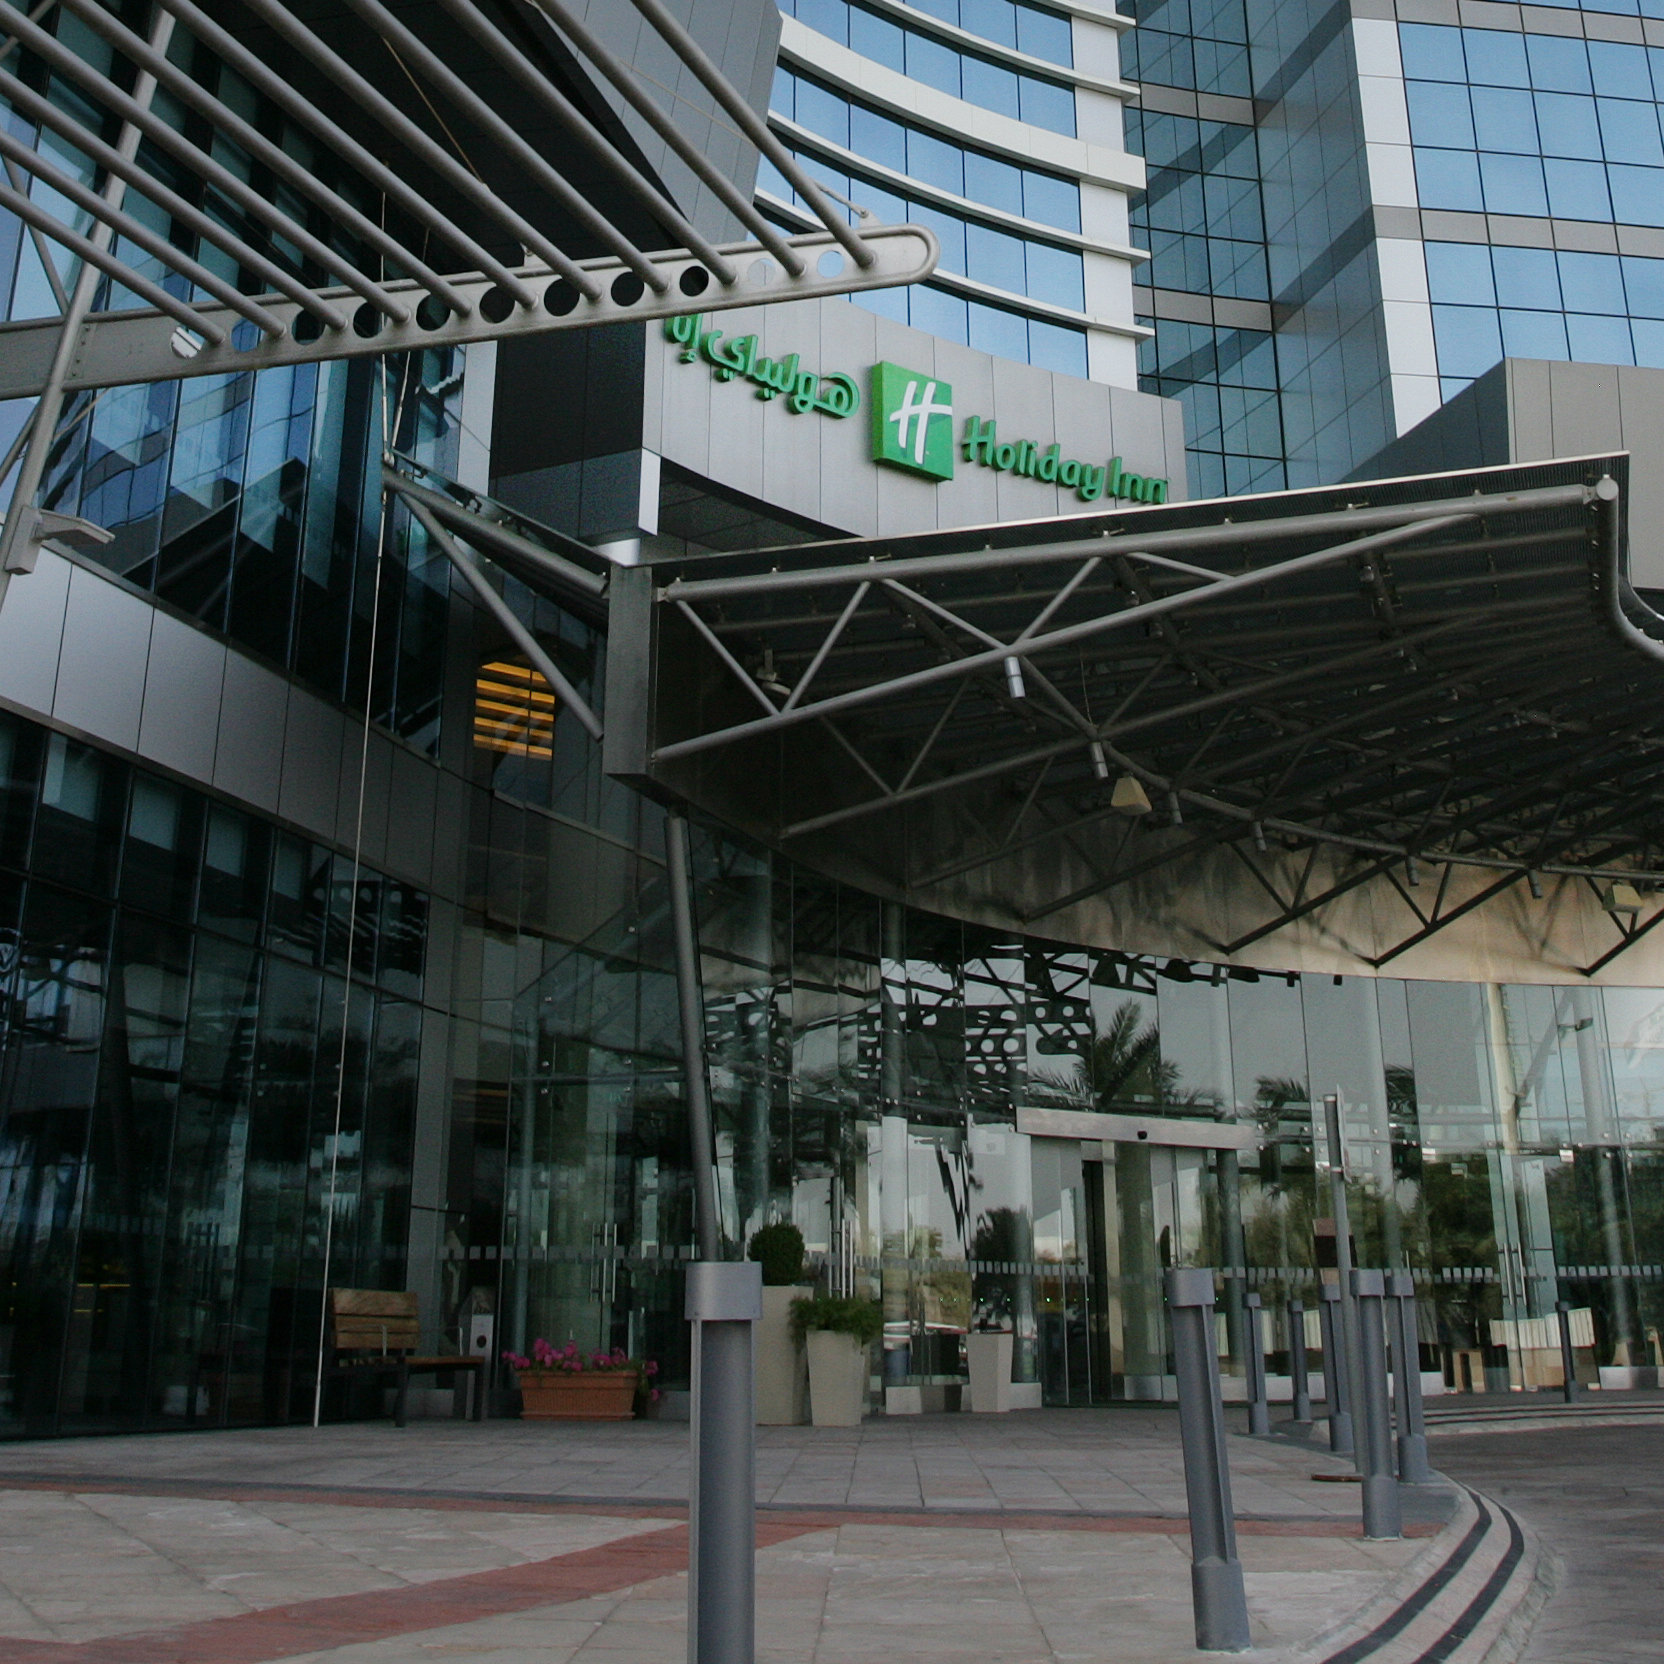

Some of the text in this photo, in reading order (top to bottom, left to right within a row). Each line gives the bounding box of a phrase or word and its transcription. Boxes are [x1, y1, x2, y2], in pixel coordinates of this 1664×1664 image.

[701, 330, 861, 419] هوليداي
[960, 415, 1169, 504] Holiday Inn
